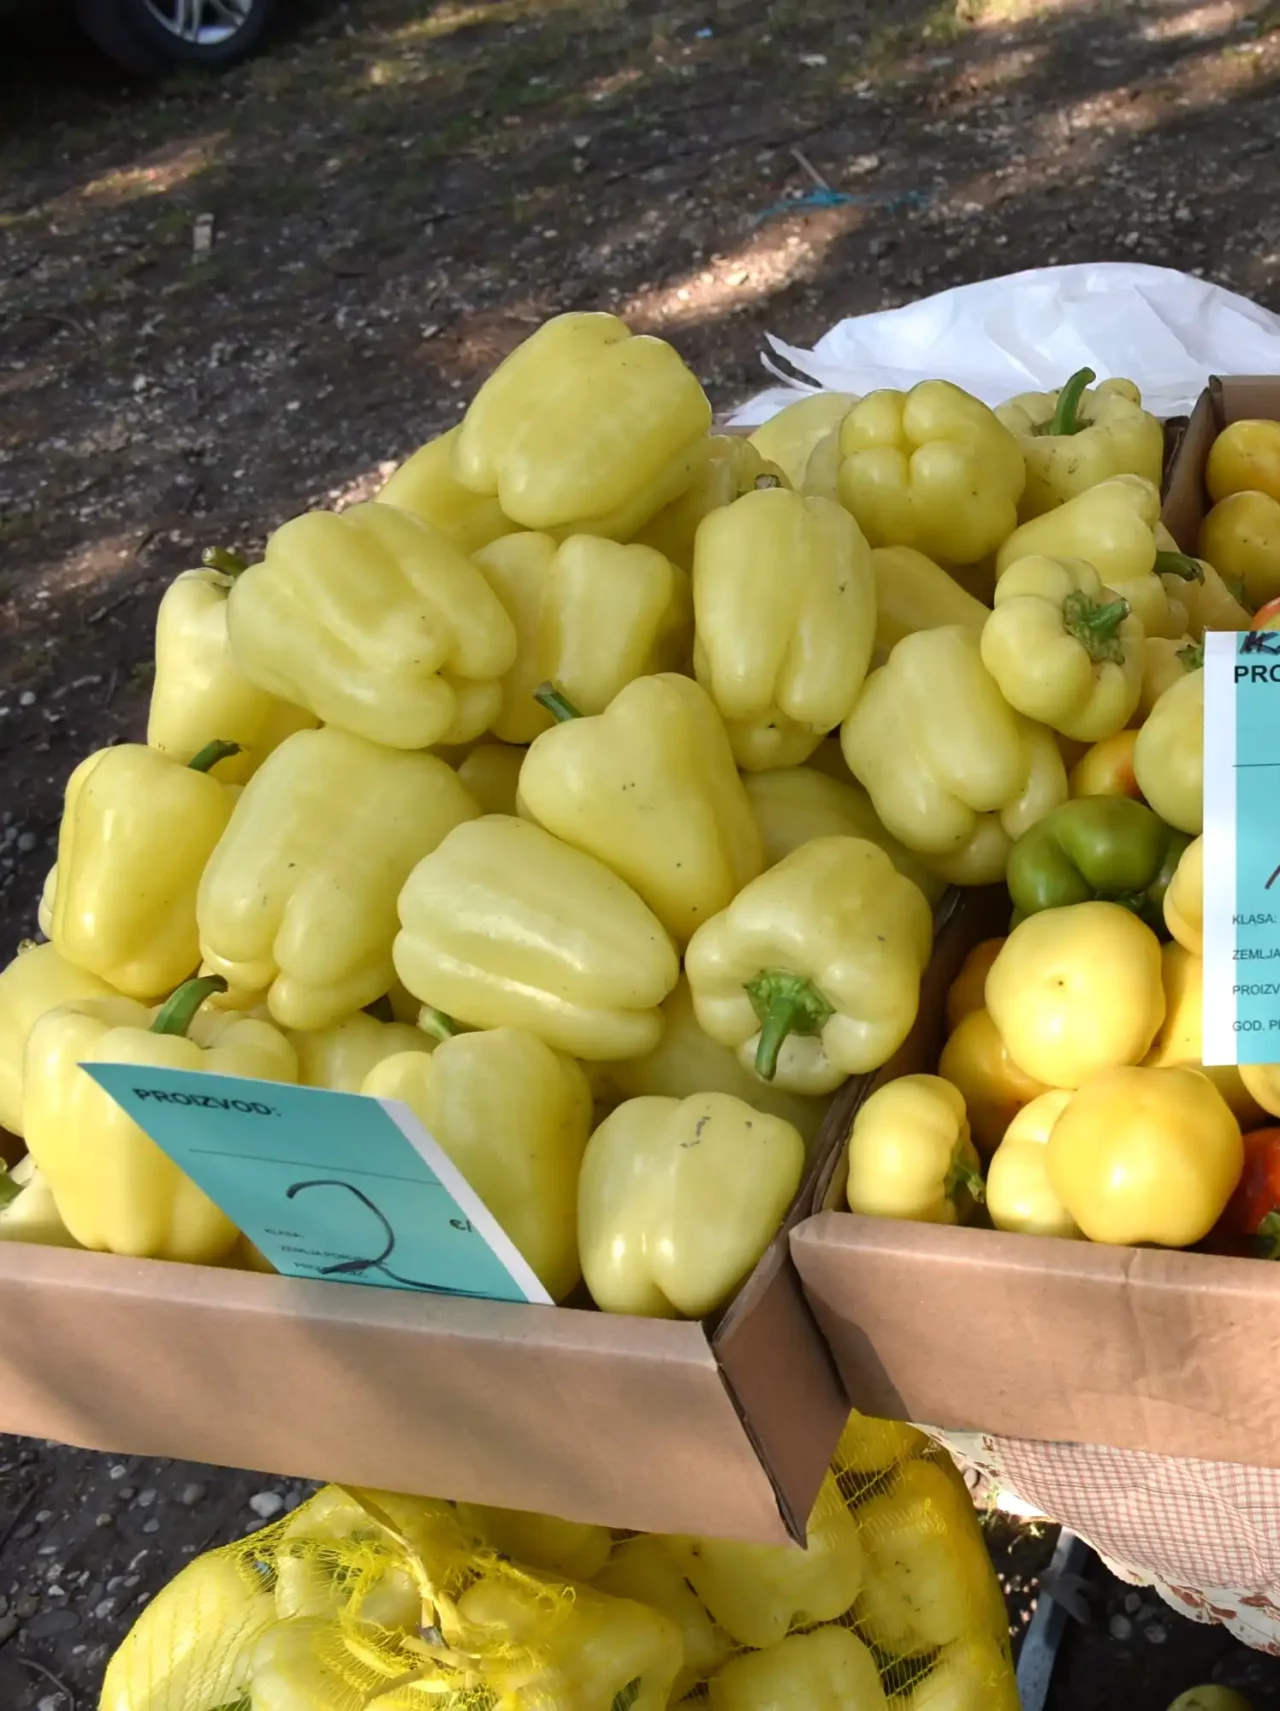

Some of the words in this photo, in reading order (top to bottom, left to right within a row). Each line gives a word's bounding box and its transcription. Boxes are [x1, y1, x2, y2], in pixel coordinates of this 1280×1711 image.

[1232, 914, 1277, 925] KLASA:
[1232, 1020, 1265, 1031] GOD.
[132, 1088, 281, 1117] PROIZVOD:
